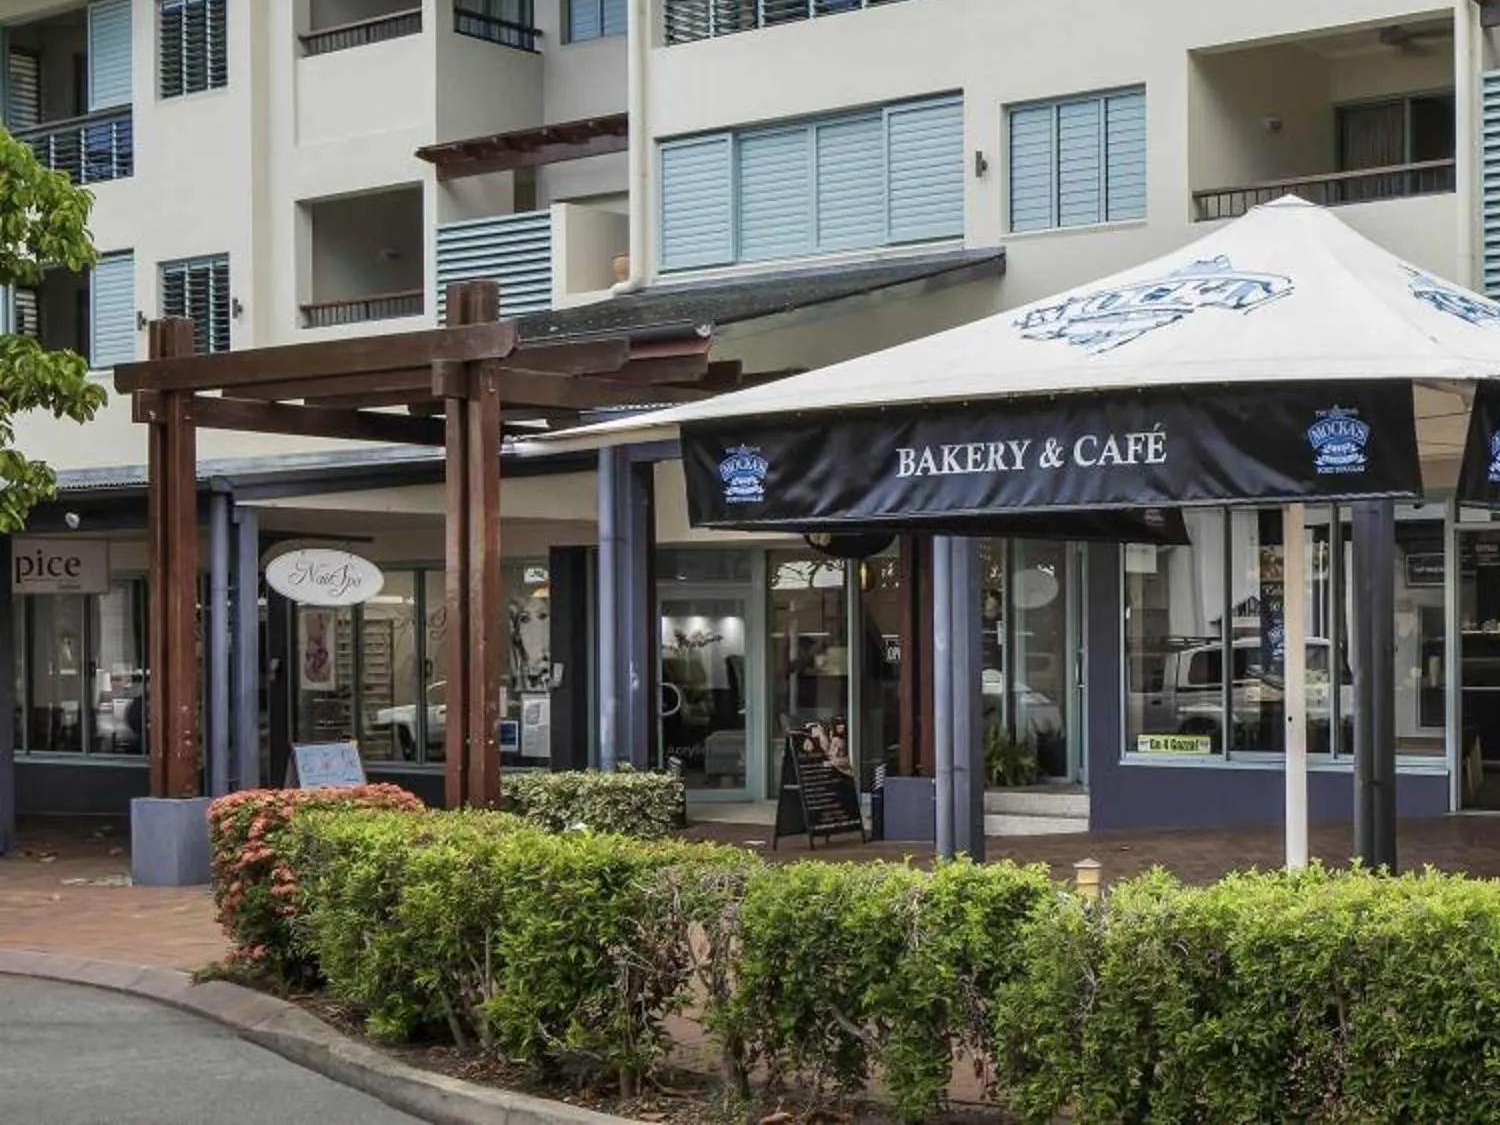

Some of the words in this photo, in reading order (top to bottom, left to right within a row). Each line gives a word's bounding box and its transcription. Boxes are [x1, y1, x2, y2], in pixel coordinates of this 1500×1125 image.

[896, 439, 1032, 477] BAKERY
[1039, 437, 1065, 468] &
[1074, 422, 1167, 467] CAFÉ
